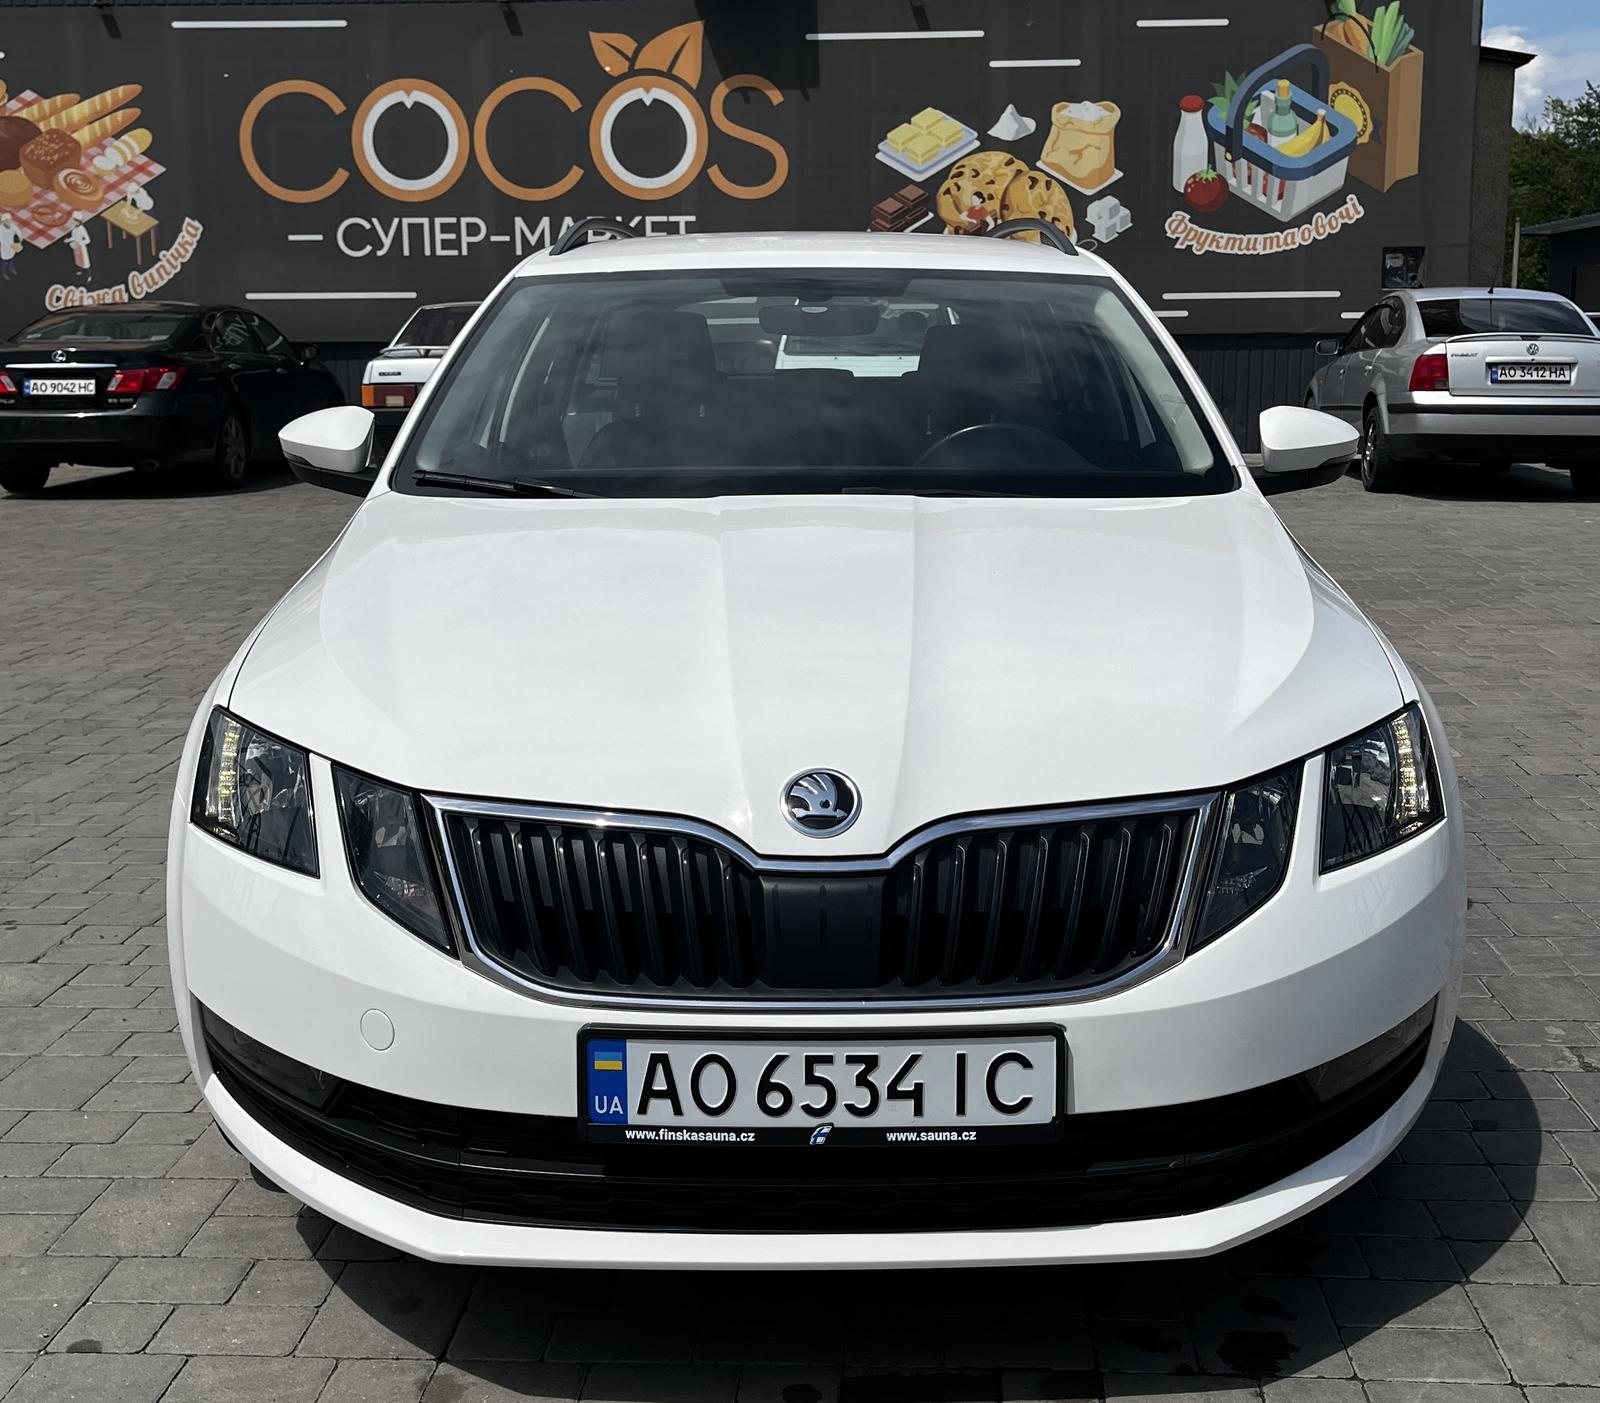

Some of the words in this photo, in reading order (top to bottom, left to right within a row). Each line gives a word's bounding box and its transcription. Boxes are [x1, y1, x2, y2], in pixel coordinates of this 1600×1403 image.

[239, 73, 789, 203] COCOS
[128, 217, 203, 299] випічка
[1500, 366, 1517, 378] AO
[1519, 366, 1546, 378] 3412
[1549, 366, 1567, 378] HA
[31, 382, 48, 393] AO
[50, 381, 76, 393] 9042
[78, 382, 95, 393] HC
[637, 1051, 737, 1117] AO
[756, 1053, 925, 1118] 6534
[955, 1051, 1034, 1117] IC
[594, 1094, 624, 1115] UA
[624, 1128, 756, 1142] www.finskasauna.cz
[886, 1130, 977, 1142] www.sauna.cz
